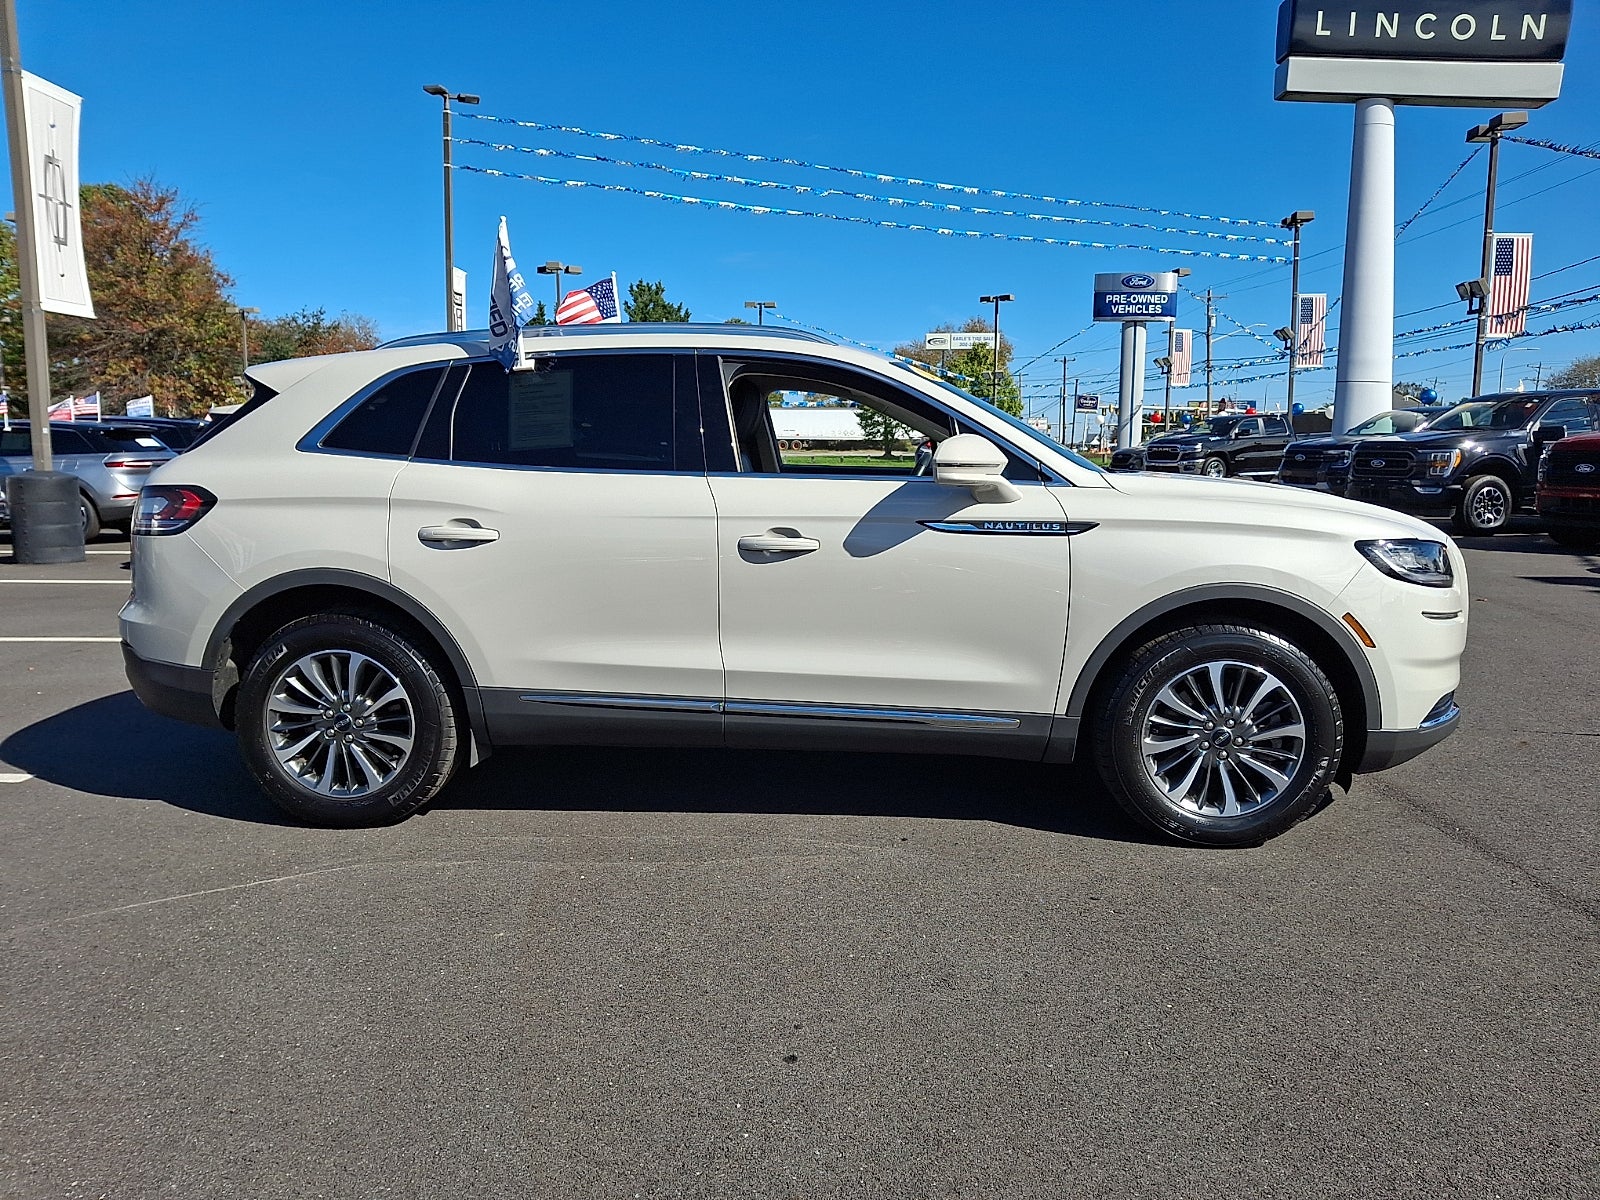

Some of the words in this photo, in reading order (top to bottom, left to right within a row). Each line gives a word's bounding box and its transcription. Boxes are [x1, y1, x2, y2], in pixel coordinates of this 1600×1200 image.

[1315, 10, 1547, 41] LINCOLN
[1105, 294, 1169, 304] PRE-OWNED
[1111, 304, 1163, 314] VEHICLES
[983, 522, 1061, 530] NAUTILUS
